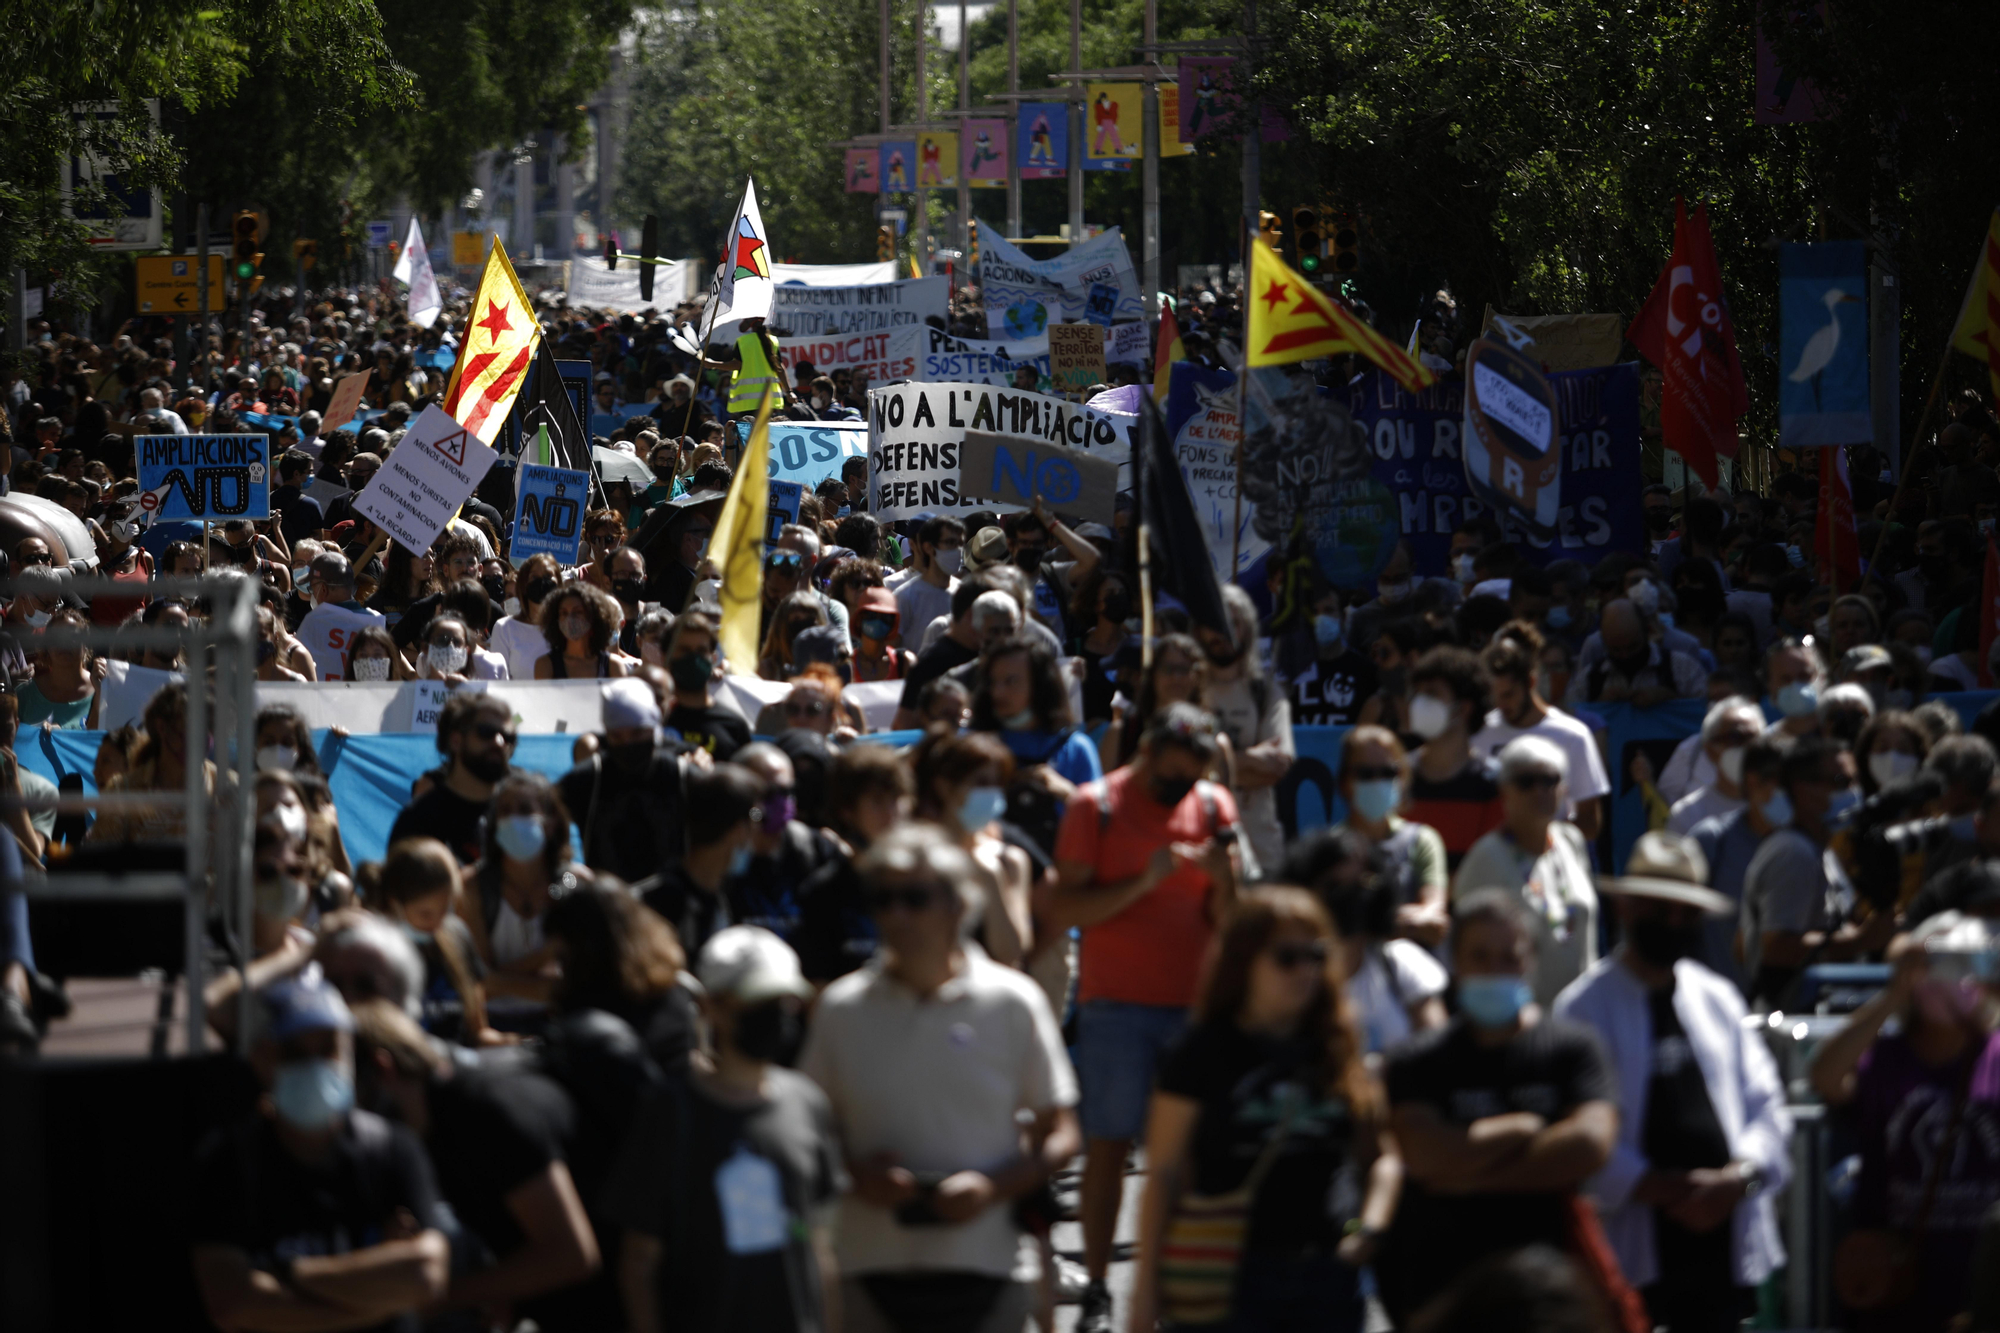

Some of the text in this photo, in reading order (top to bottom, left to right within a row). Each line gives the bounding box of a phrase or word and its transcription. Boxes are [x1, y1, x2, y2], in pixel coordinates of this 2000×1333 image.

[1056, 327, 1094, 341] SENSE
[779, 333, 892, 370] SINDICAT
[1058, 357, 1074, 369] NO
[1086, 357, 1101, 369] HA
[874, 391, 904, 435] NO
[913, 391, 935, 428] A
[1205, 410, 1240, 428] AMPL
[1189, 425, 1204, 438] DE
[143, 437, 263, 467] AMPLIACIONS
[413, 438, 471, 485] MENOS AVIONES
[872, 441, 963, 475] DEFENS
[1178, 445, 1218, 464] FONS
[527, 468, 584, 486] AMPLIACIONS
[1192, 467, 1236, 483] PRECAR
[160, 465, 250, 516] NO
[393, 463, 453, 511] MENOS TURISTAS
[409, 490, 421, 503] NO
[366, 505, 373, 513] A
[378, 483, 439, 531] CONTAMINACION
[395, 511, 404, 520] SI
[521, 493, 579, 538] NO
